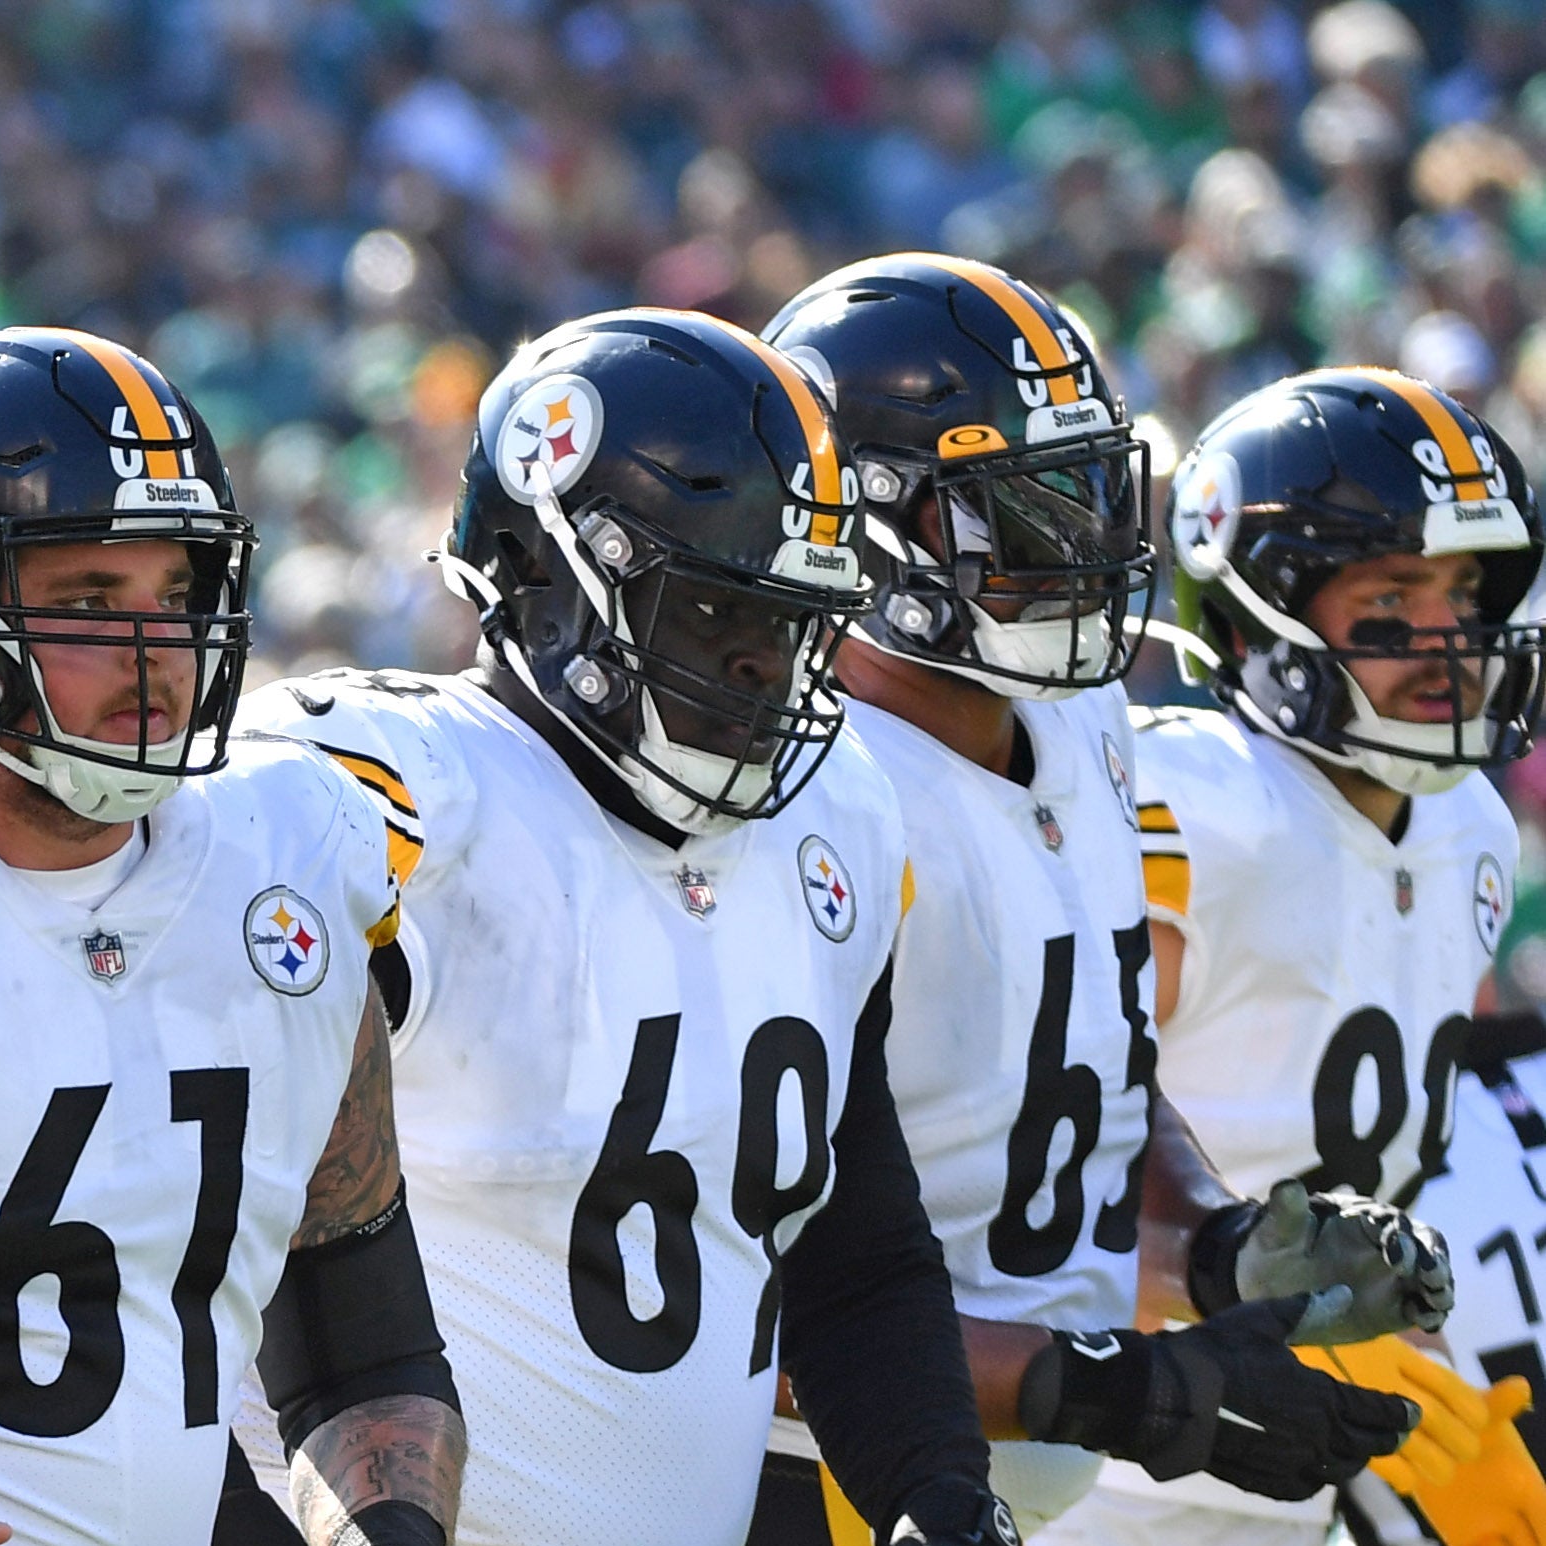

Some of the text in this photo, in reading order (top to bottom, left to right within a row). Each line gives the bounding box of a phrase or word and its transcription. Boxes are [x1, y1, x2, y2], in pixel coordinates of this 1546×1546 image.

[1052, 405, 1097, 428] Steelers
[109, 405, 196, 478] 61
[145, 482, 200, 503] Steelers
[782, 462, 860, 543] 69
[805, 547, 847, 572] Steelers
[251, 932, 285, 945] Steelers
[92, 952, 123, 974] NFL
[569, 1012, 831, 1378] 69
